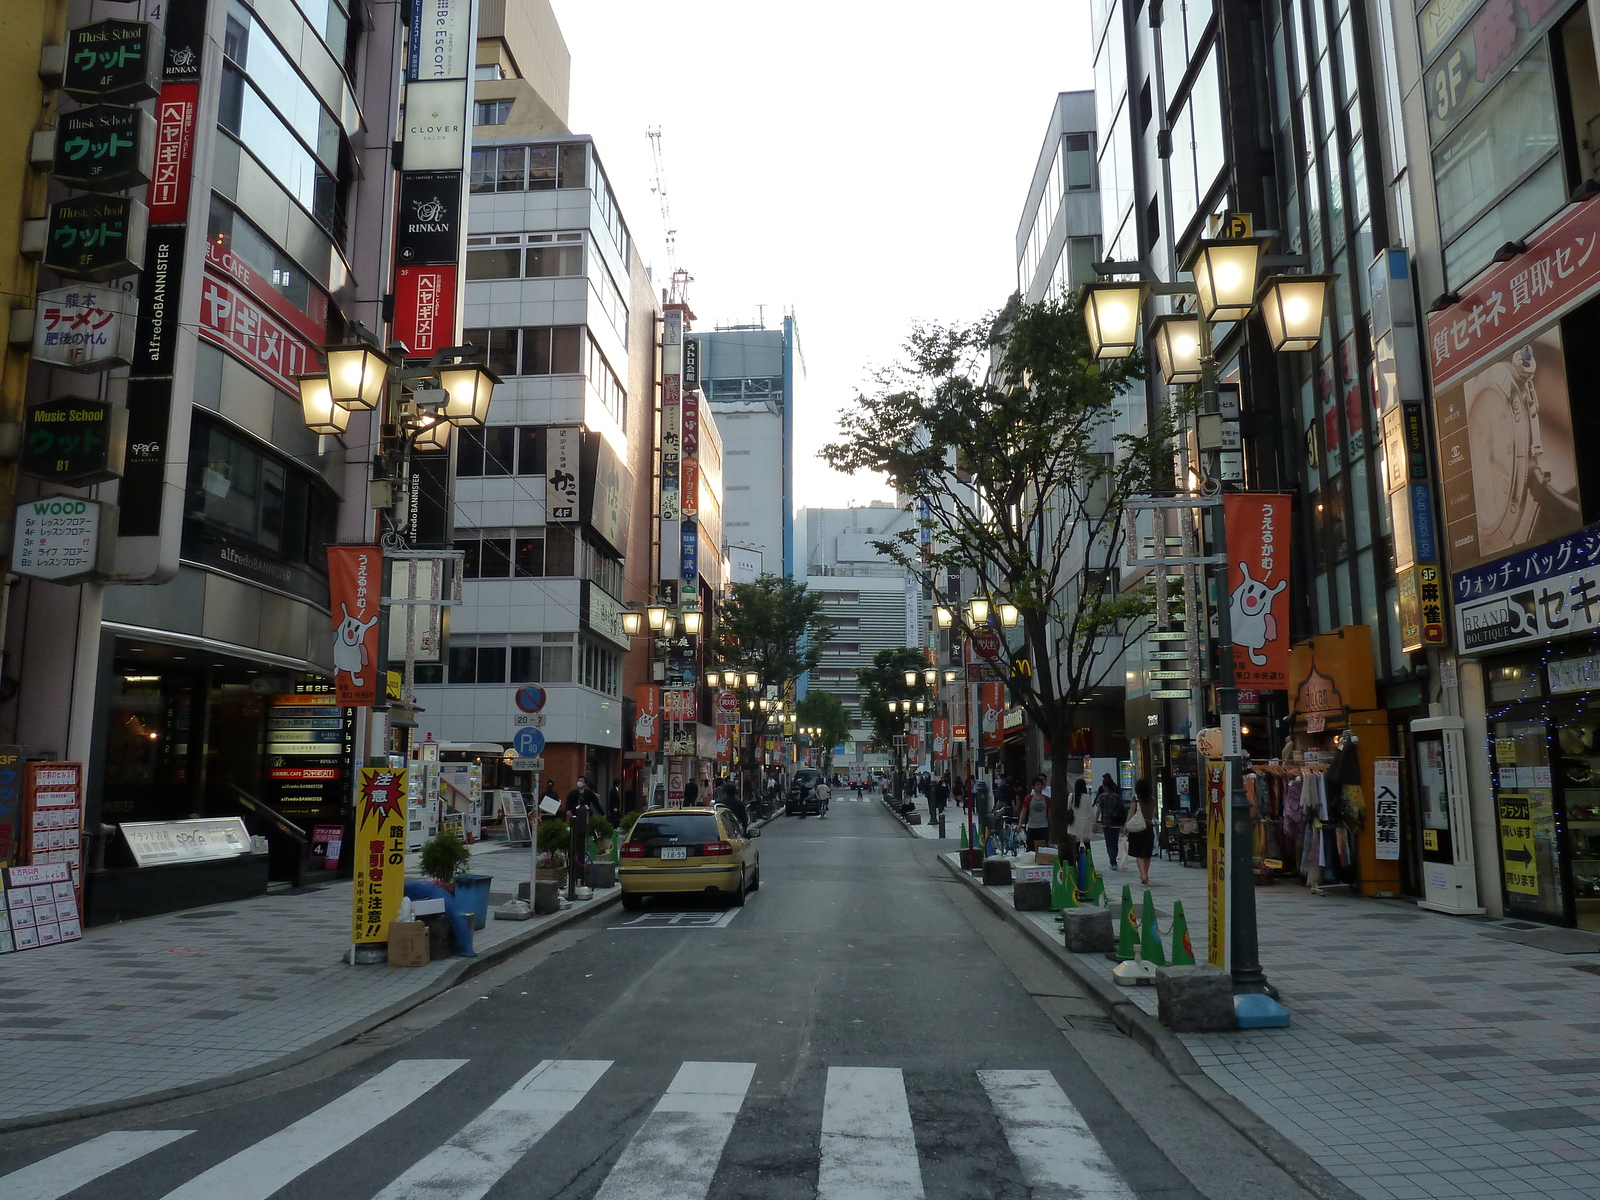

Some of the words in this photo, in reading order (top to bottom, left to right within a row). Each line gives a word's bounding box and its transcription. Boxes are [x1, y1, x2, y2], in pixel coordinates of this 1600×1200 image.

[79, 30, 110, 43] Music
[112, 28, 141, 40] School
[74, 44, 141, 71] ウッド
[434, 31, 447, 76] Escort
[165, 65, 197, 75] RINKAN
[100, 75, 113, 85] 4F
[1435, 50, 1462, 119] 3F
[69, 117, 97, 130] Music
[100, 114, 133, 127] School
[411, 126, 459, 134] CLOVER
[64, 132, 133, 161] ウッド
[160, 106, 183, 201] ヘヤギメ!
[91, 166, 103, 175] 3F
[59, 207, 90, 219] Music
[93, 205, 123, 217] School
[54, 221, 122, 248] ウッド
[408, 223, 450, 233] RINKAN
[80, 255, 93, 265] 2F
[403, 249, 412, 257] 4F
[222, 254, 250, 286] CAFE
[65, 292, 96, 308] 熊本
[150, 243, 169, 361] alfredoBANNISTER
[1433, 290, 1506, 367] 質セキネ
[1509, 232, 1596, 314] 買取セン
[44, 308, 114, 331] ラーメン
[418, 277, 433, 348] ヘヤギメ!
[45, 332, 107, 346] 肥後のれん
[69, 349, 83, 359] 1F
[35, 409, 66, 423] Music
[69, 409, 103, 421] School
[1444, 410, 1460, 423] ROLEX
[683, 411, 697, 444] つぼ八
[29, 429, 104, 455] ウッド
[57, 460, 69, 471] B1
[1448, 454, 1465, 467] CHANEL
[548, 469, 577, 504] かっこ
[34, 502, 86, 516] WOOD
[555, 508, 570, 518] 4F
[26, 518, 36, 527] 5F
[41, 516, 92, 527] レッスンフロアー
[1420, 514, 1429, 541] salon
[25, 528, 35, 536] 4F
[40, 527, 91, 537] レッスンフロアー
[24, 538, 34, 546] 3F
[1261, 504, 1275, 583] うえるかむ!
[22, 548, 33, 556] 2F
[1420, 542, 1431, 557] Nail
[21, 558, 32, 567] B2
[37, 557, 88, 567] レッスンフロアー
[683, 545, 695, 570] 西武
[220, 547, 292, 583] alfredoBANNISTER
[1423, 570, 1435, 580] 3F
[357, 553, 368, 620] うえるかむ!
[1465, 608, 1508, 632] BRAND
[1466, 626, 1510, 645] BOUTIQUE
[1235, 672, 1250, 680] 東口
[1254, 671, 1285, 681] 中央通り
[346, 732, 351, 740] 6
[345, 745, 351, 753] 5
[528, 744, 538, 754] 40
[371, 773, 395, 817] 注意!
[1377, 786, 1398, 843] 入居募集
[1501, 806, 1529, 817] ブランド
[1502, 825, 1532, 839] 買います
[389, 825, 404, 865] 路上の
[1506, 874, 1536, 888] 売ります
